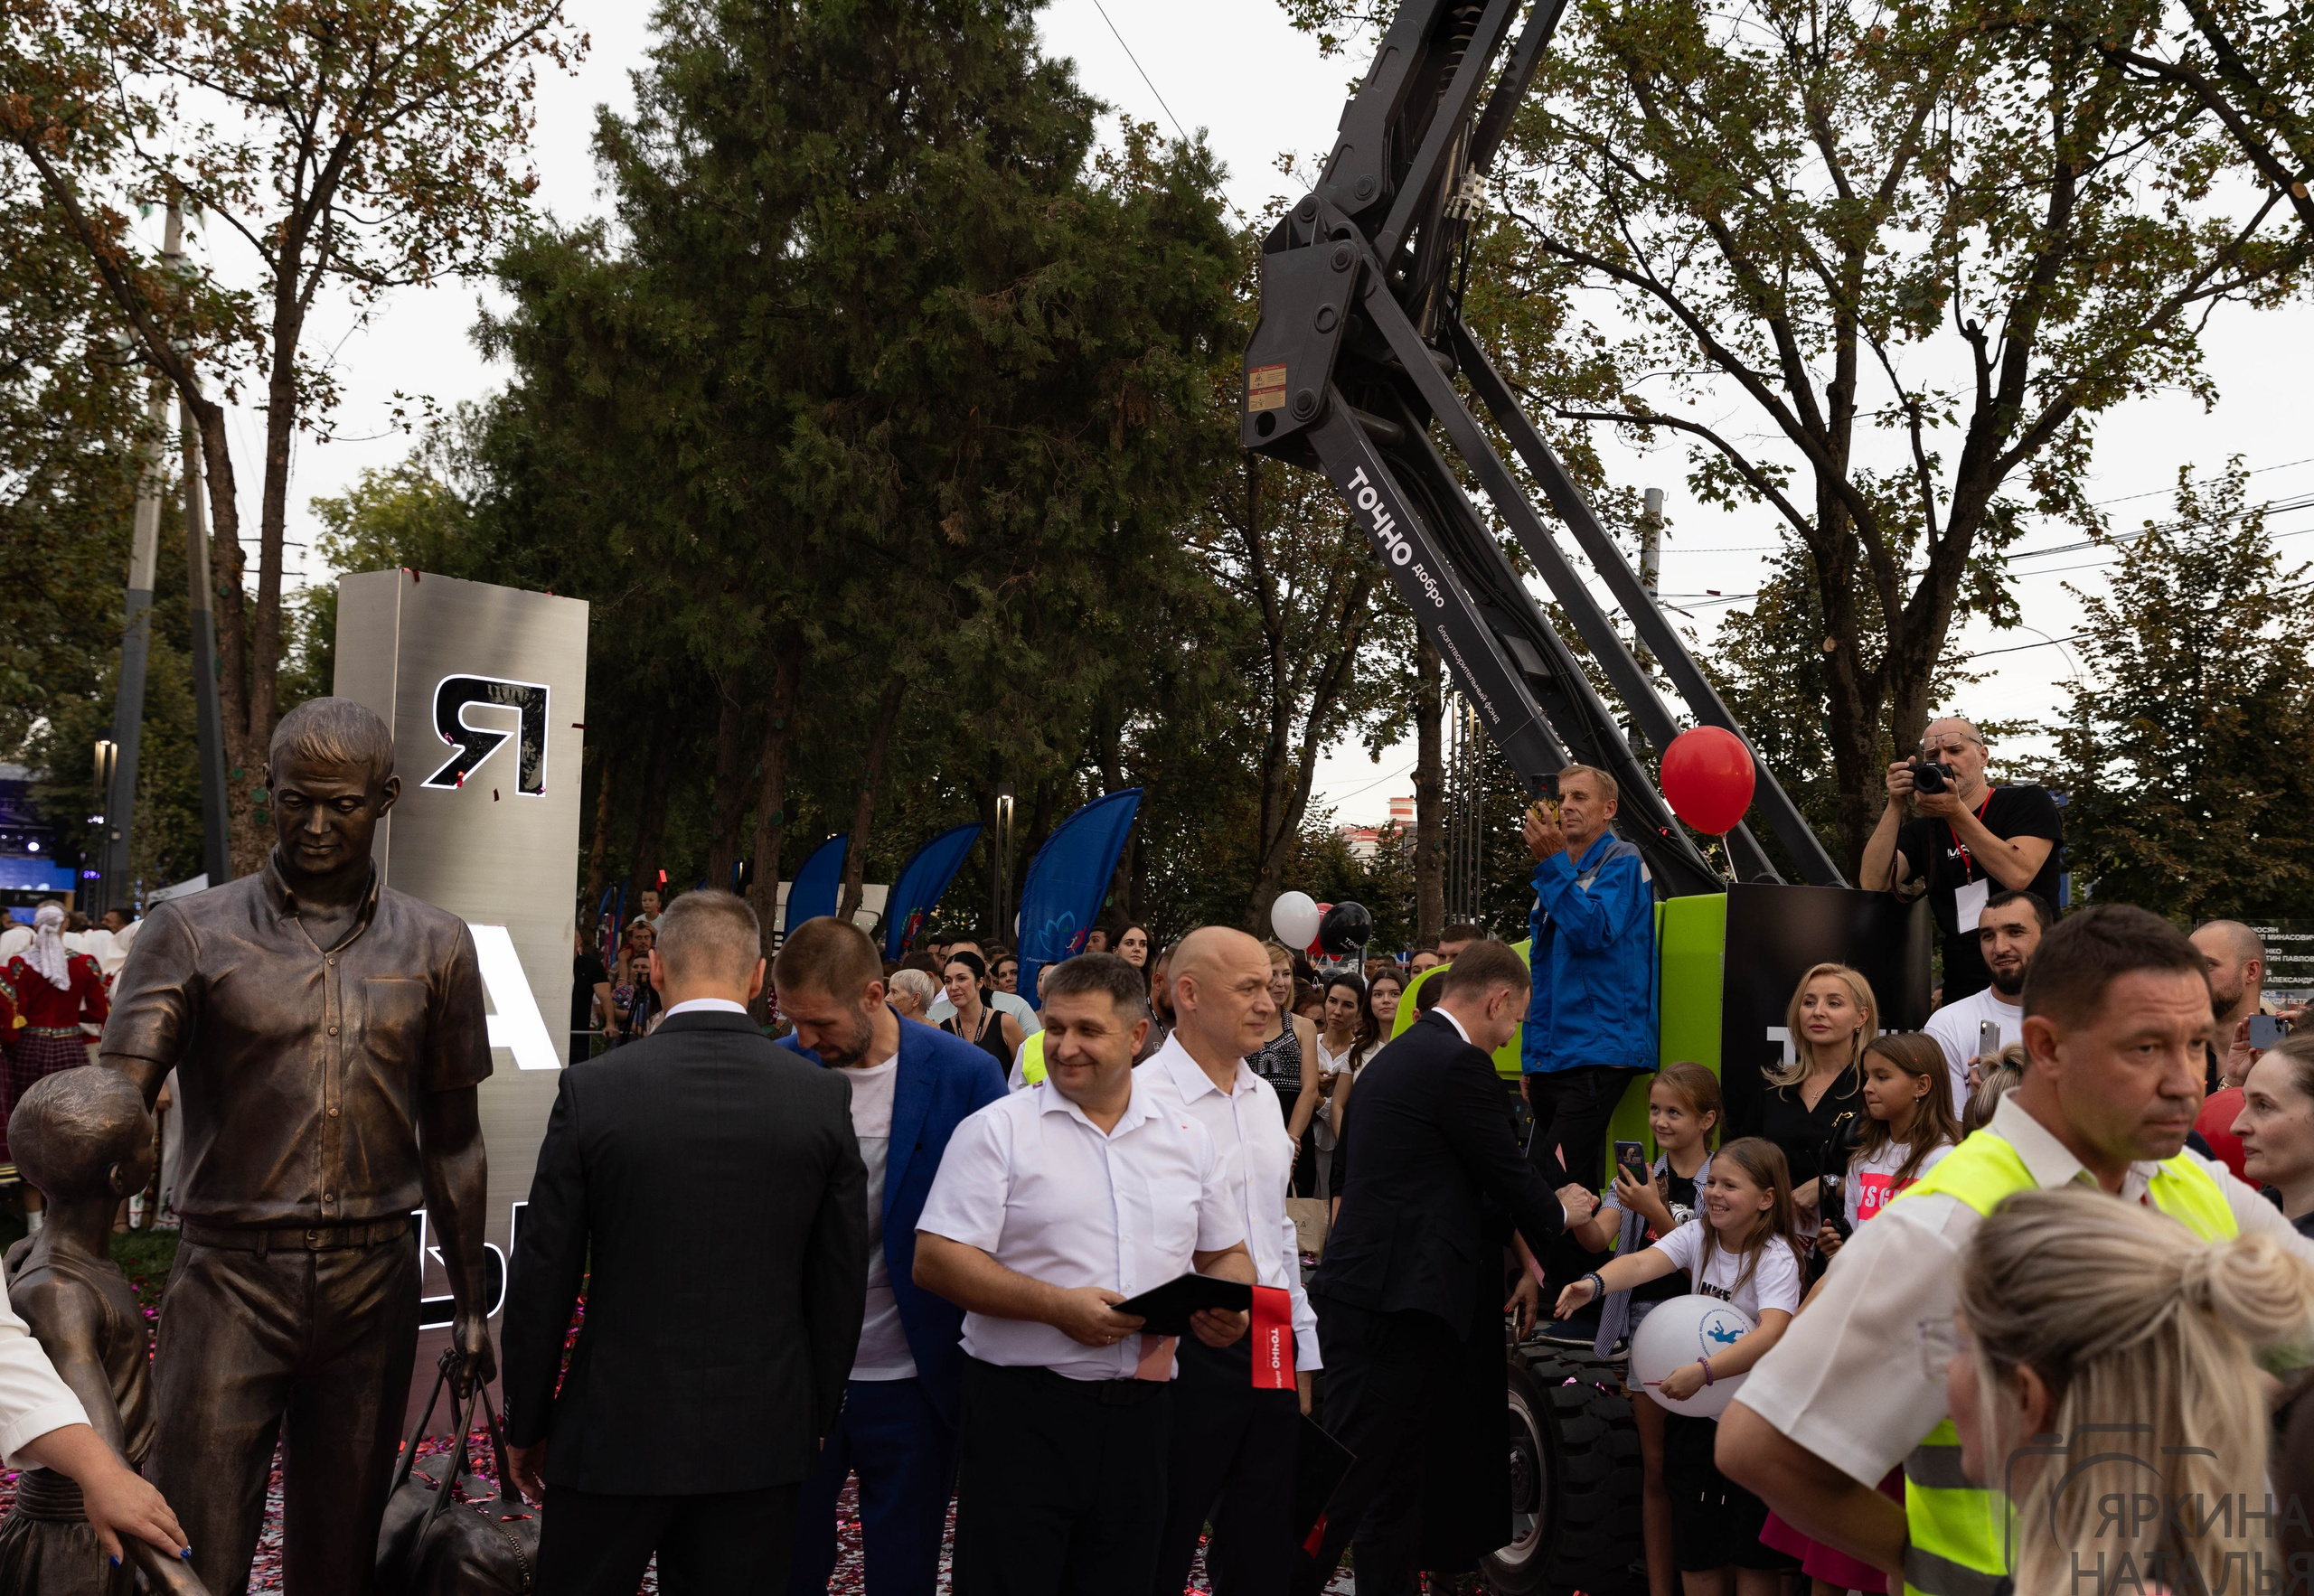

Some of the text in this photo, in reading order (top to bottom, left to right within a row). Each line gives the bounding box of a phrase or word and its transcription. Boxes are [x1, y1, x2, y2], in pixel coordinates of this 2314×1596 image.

[1347, 465, 1444, 608] ТОЧНО добро
[1437, 624, 1500, 725] благотворительный фонд
[419, 673, 550, 798] Я
[2267, 976, 2314, 984] АЛЕКСАНДР
[1858, 1185, 1901, 1209] SG
[1271, 1328, 1280, 1368] ТОЧНО
